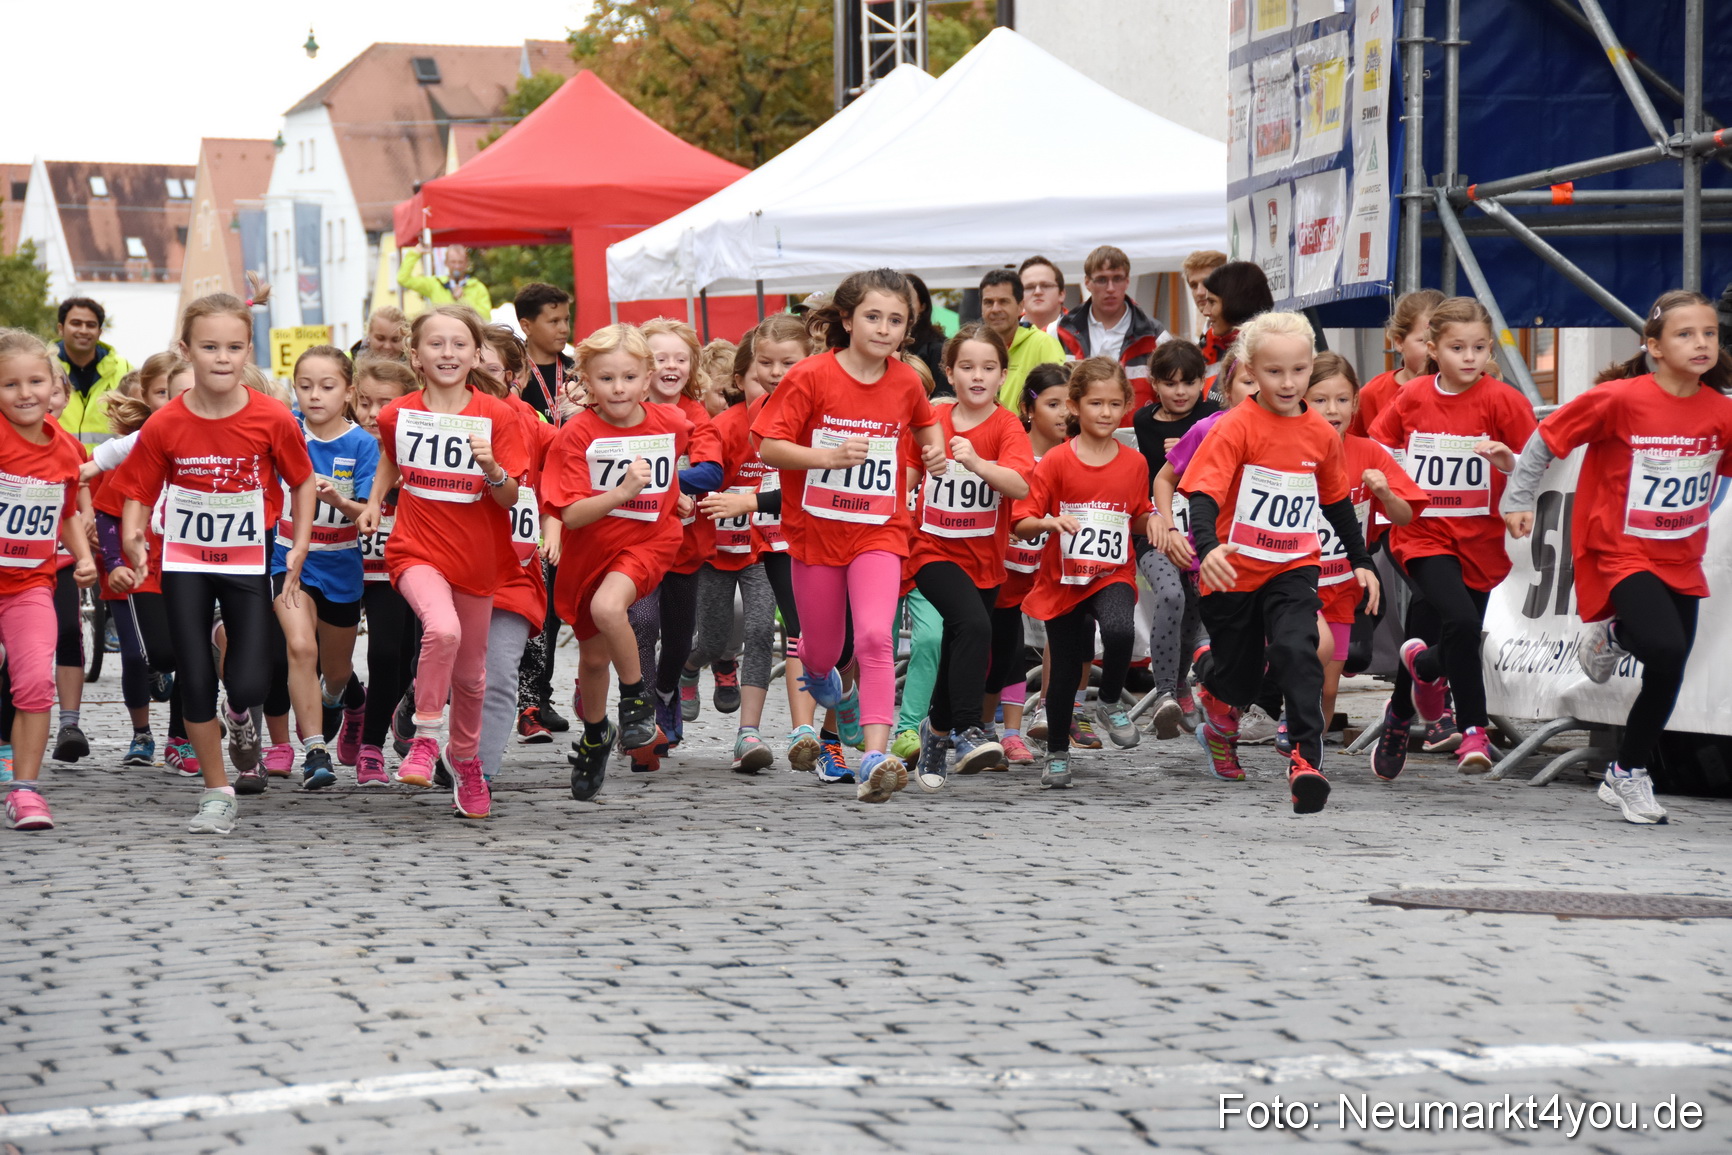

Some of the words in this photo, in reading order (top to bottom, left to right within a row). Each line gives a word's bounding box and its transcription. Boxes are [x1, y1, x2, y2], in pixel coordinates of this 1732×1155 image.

[281, 344, 291, 366] E
[439, 416, 484, 431] BOCK
[823, 414, 883, 429] Neumarkter
[629, 438, 669, 451] BOCK
[1631, 434, 1696, 446] Neumarkter
[1414, 454, 1483, 487] 7070
[409, 471, 473, 491] Annemarie
[1251, 475, 1283, 487] NeuerMarkt
[26, 487, 60, 498] BOCK
[932, 475, 993, 508] 7190
[1643, 471, 1712, 508] 7209
[209, 493, 256, 506] BOCK
[832, 494, 871, 511] Emilia
[1249, 488, 1316, 528] 7087
[176, 508, 257, 542] 7074
[940, 513, 976, 527] Loreen
[1655, 514, 1695, 530] Sophia
[1256, 532, 1299, 550] Hannah
[4, 543, 30, 556] Leni
[202, 550, 229, 562] Lisa
